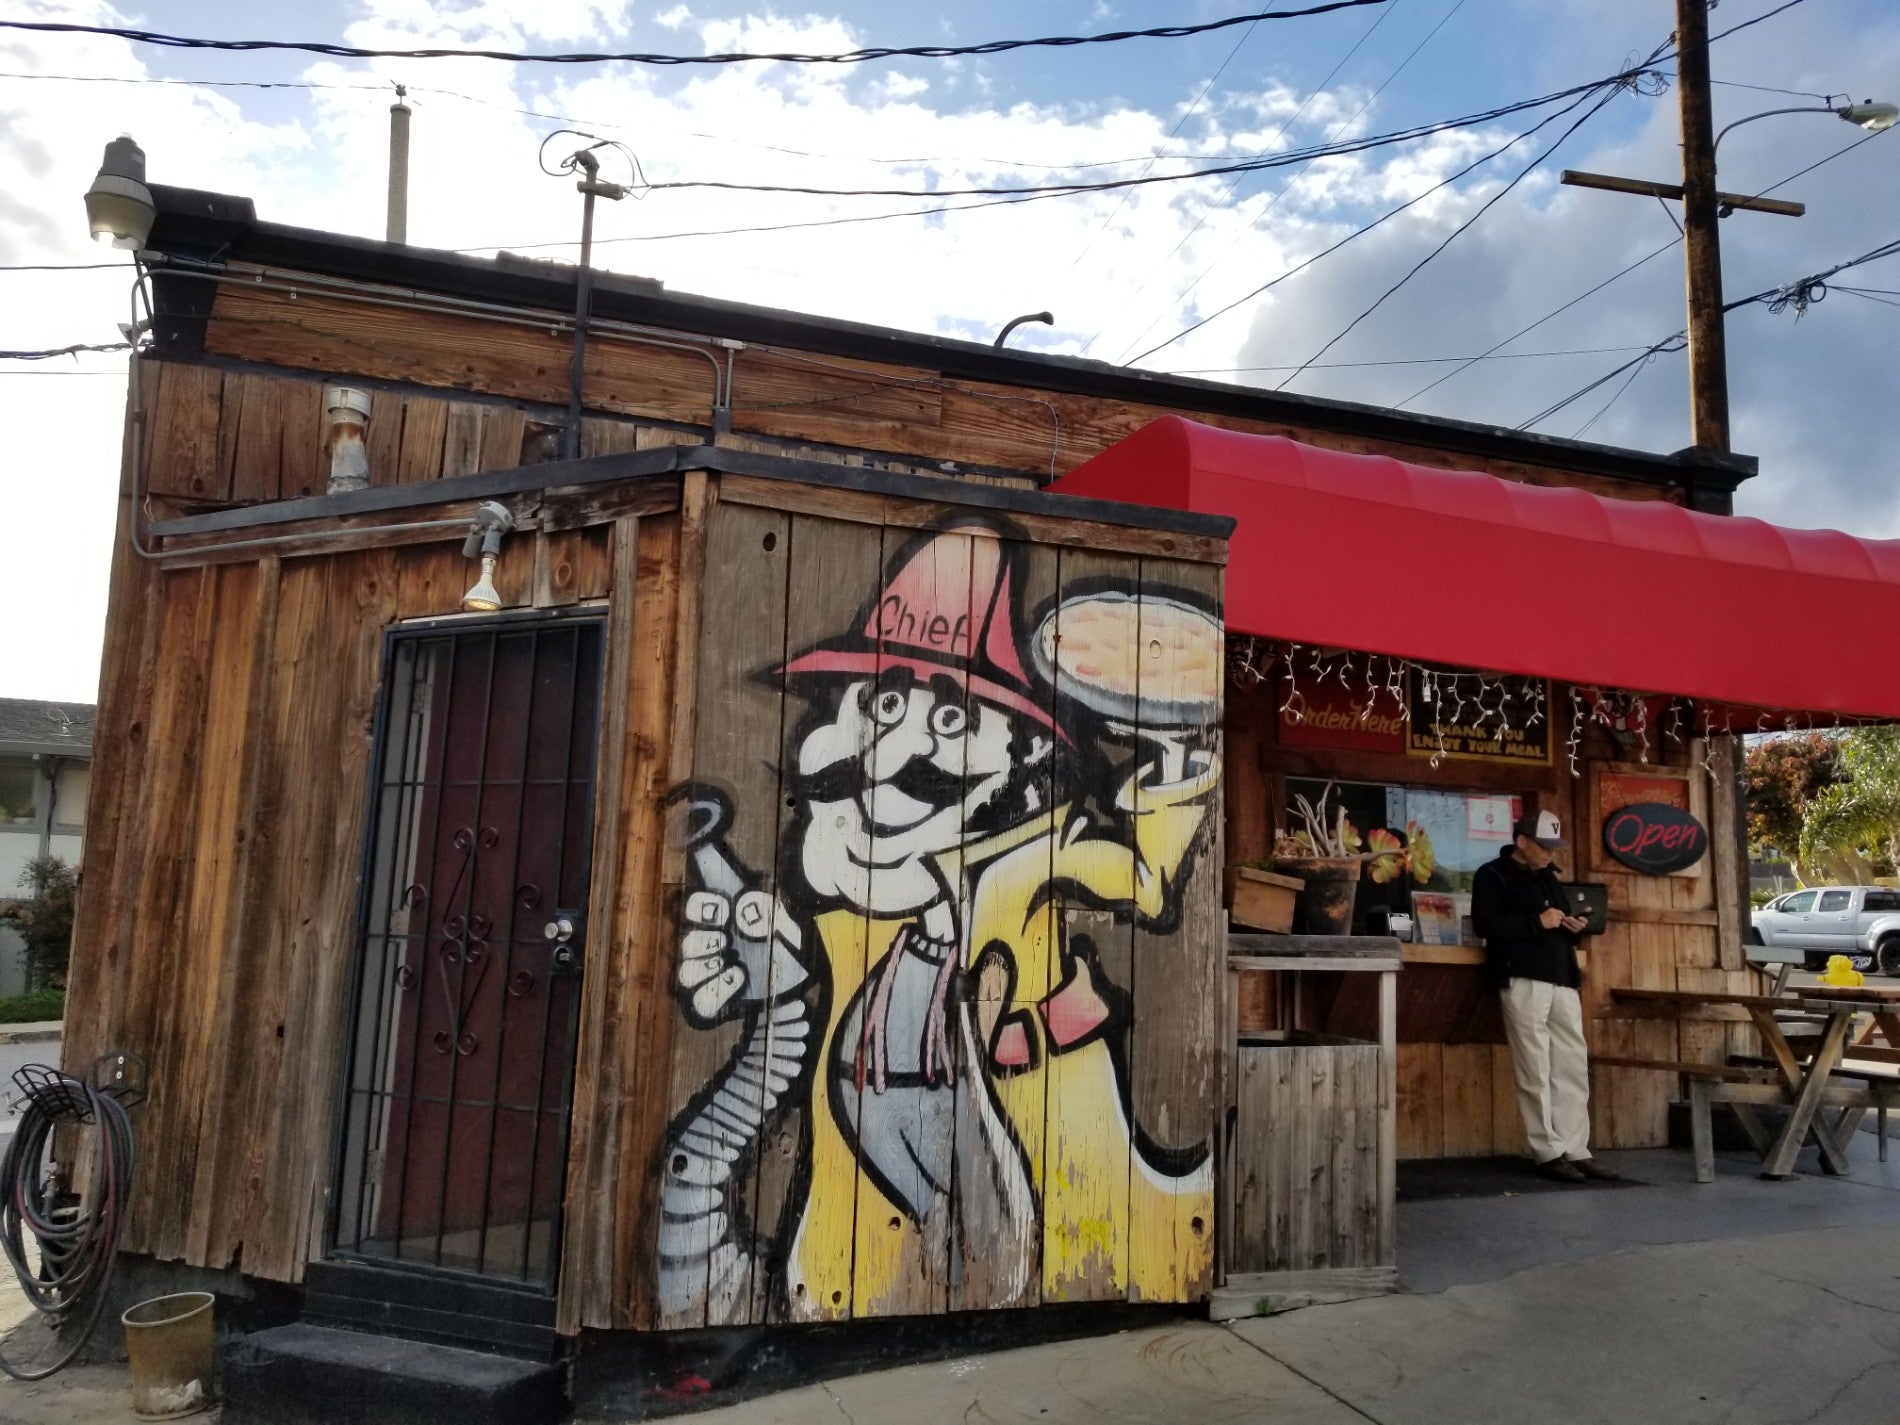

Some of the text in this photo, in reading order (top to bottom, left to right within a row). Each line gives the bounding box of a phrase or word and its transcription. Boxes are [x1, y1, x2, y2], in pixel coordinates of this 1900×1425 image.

[876, 594, 971, 653] Chief
[1284, 692, 1351, 730] Order
[1428, 722, 1487, 739] THANK
[1467, 738, 1502, 755] YOUR
[1505, 741, 1546, 758] MEAL
[1551, 822, 1560, 835] V
[1608, 813, 1698, 856] Open
